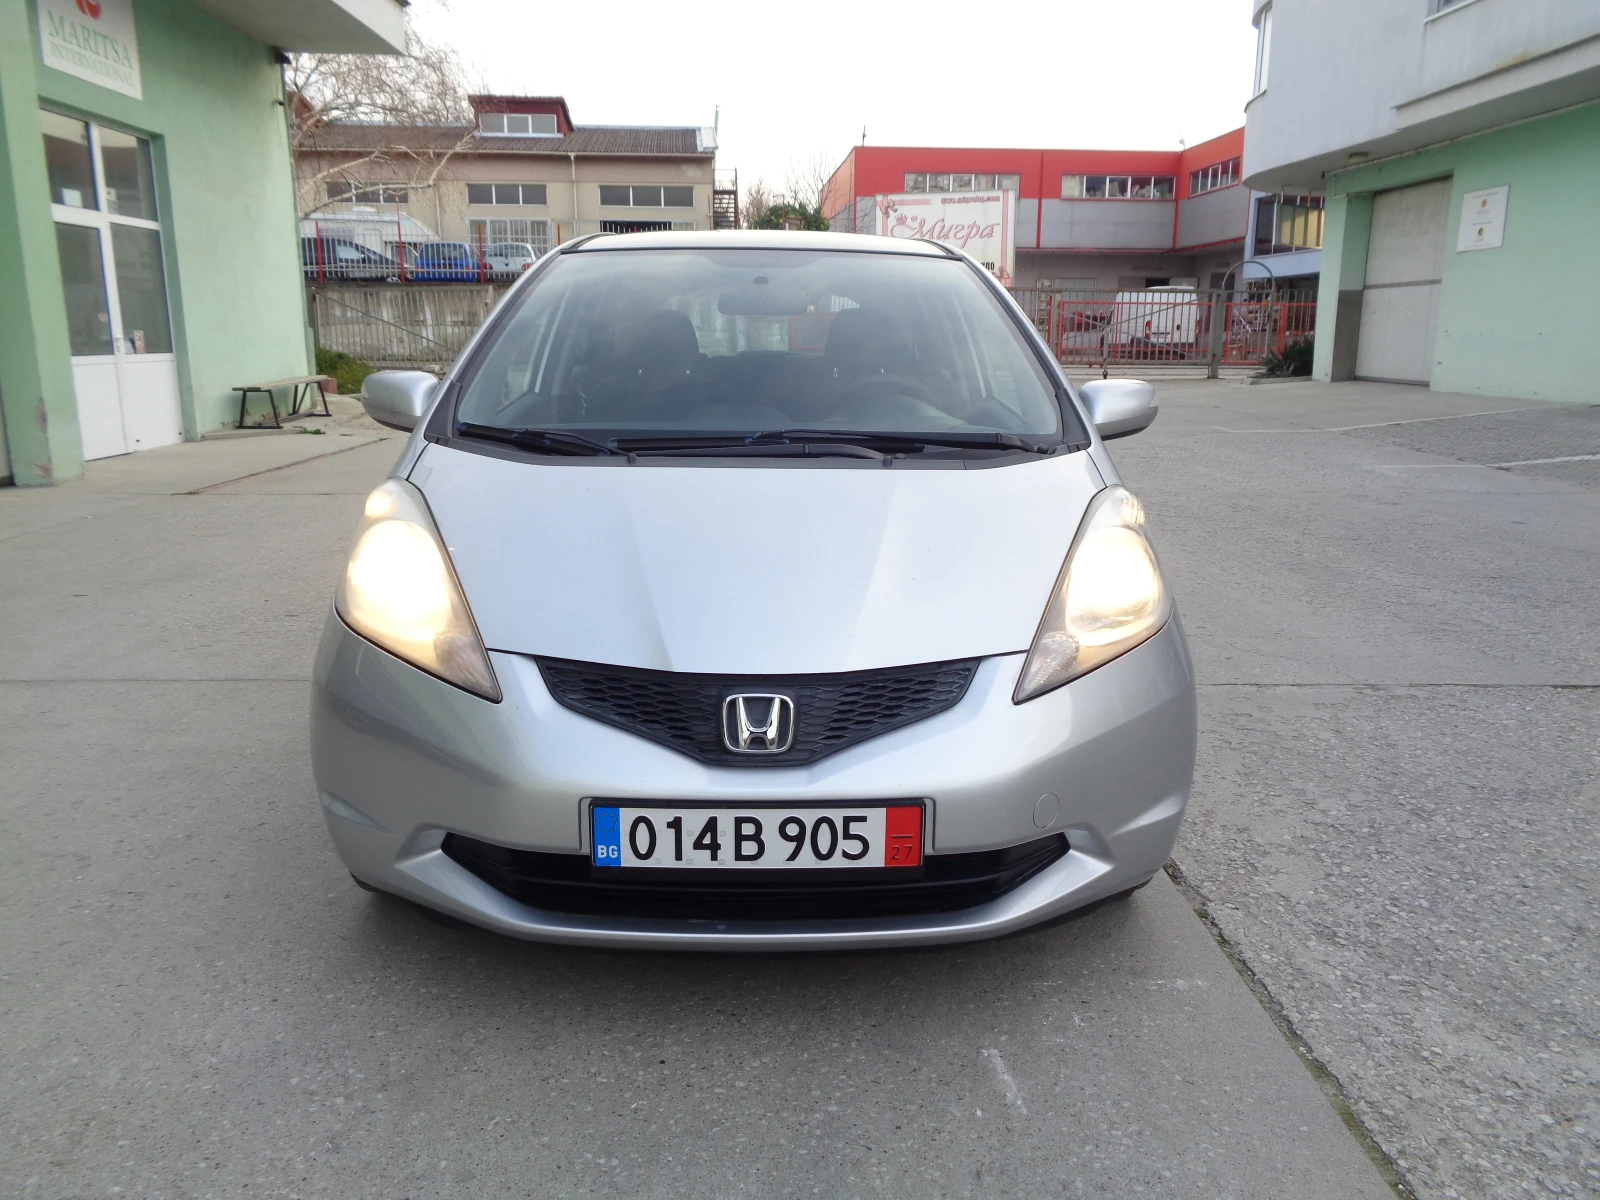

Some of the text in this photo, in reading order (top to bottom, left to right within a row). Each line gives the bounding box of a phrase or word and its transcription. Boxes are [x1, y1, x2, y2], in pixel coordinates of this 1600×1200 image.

[47, 10, 133, 70] MARITSA
[903, 217, 1000, 249] Мигра
[597, 844, 619, 858] BG
[629, 815, 722, 862] 014
[778, 815, 870, 862] 905
[891, 844, 913, 860] 27
